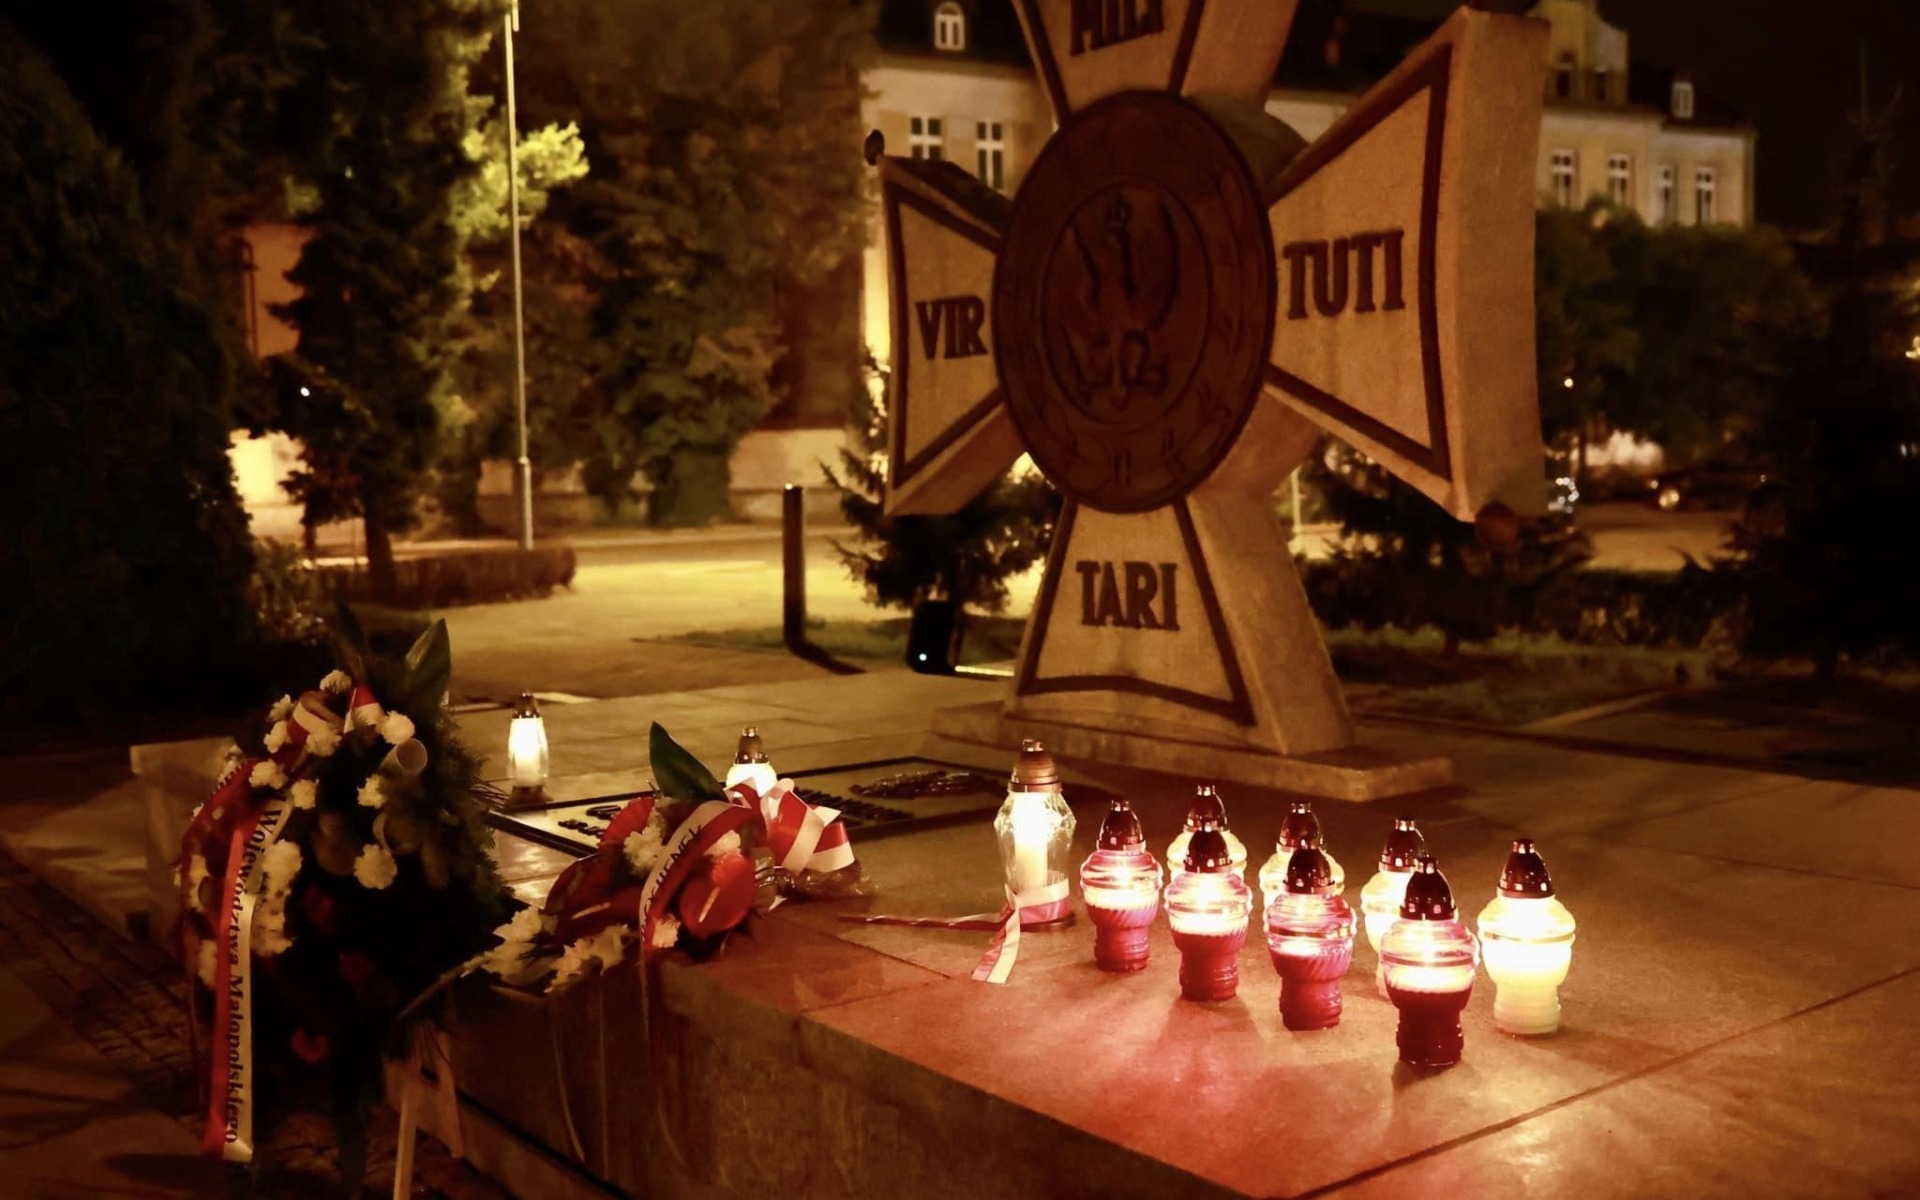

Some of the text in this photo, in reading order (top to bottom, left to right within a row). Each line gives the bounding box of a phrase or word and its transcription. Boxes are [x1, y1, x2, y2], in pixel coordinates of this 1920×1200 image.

[1284, 230, 1406, 319] TUTI
[915, 296, 987, 360] VIR
[1076, 561, 1180, 631] TARI
